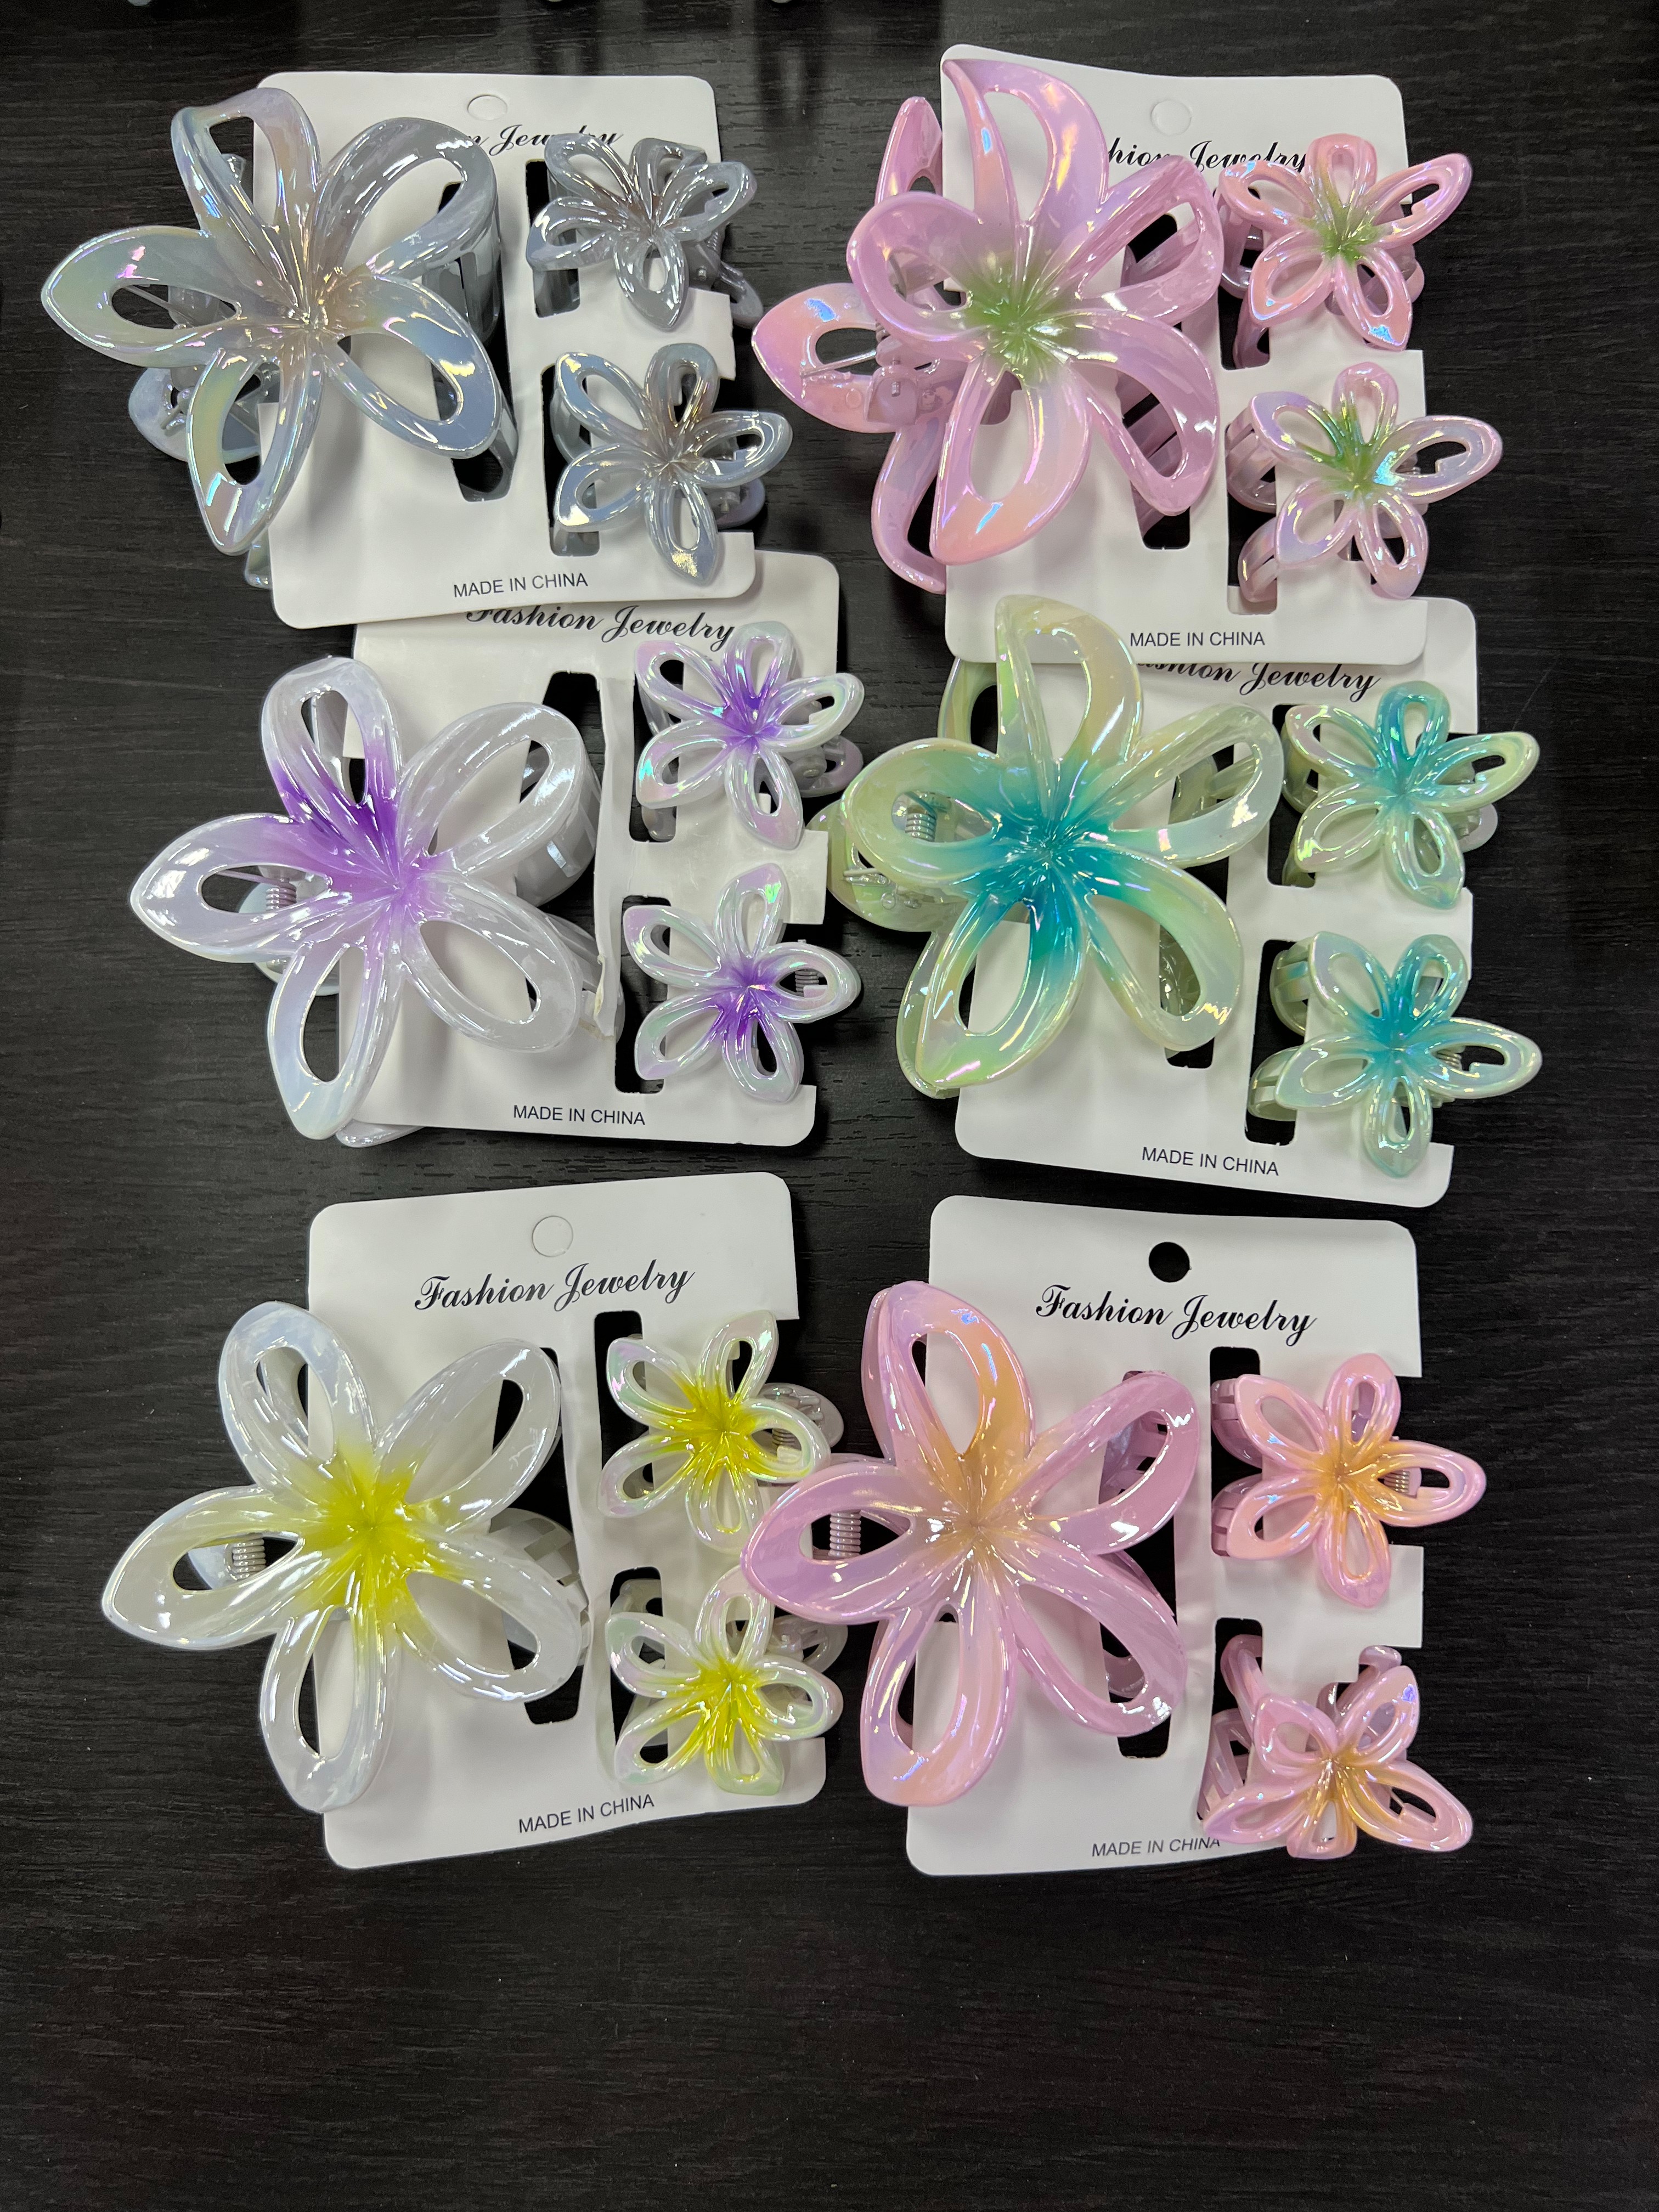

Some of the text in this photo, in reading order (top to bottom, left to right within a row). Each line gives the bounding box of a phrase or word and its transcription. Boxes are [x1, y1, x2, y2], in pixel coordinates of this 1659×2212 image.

[488, 124, 624, 156] Jewy
[454, 573, 588, 597] MADE IN CHINA
[601, 605, 735, 652] Jewelry
[1131, 632, 1265, 646] MADE IN CHINA
[1239, 663, 1381, 702] Jewelry
[514, 1105, 645, 1125] MADE IN CHINA
[1142, 1147, 1279, 1176] MADE IN CHINA
[414, 1259, 696, 1312] Fashion Jewelry
[1035, 1284, 1317, 1347] Fashion Jewelry
[519, 1794, 654, 1833] MADE IN CHINA
[1092, 1837, 1220, 1857] MADE IN CHINA
